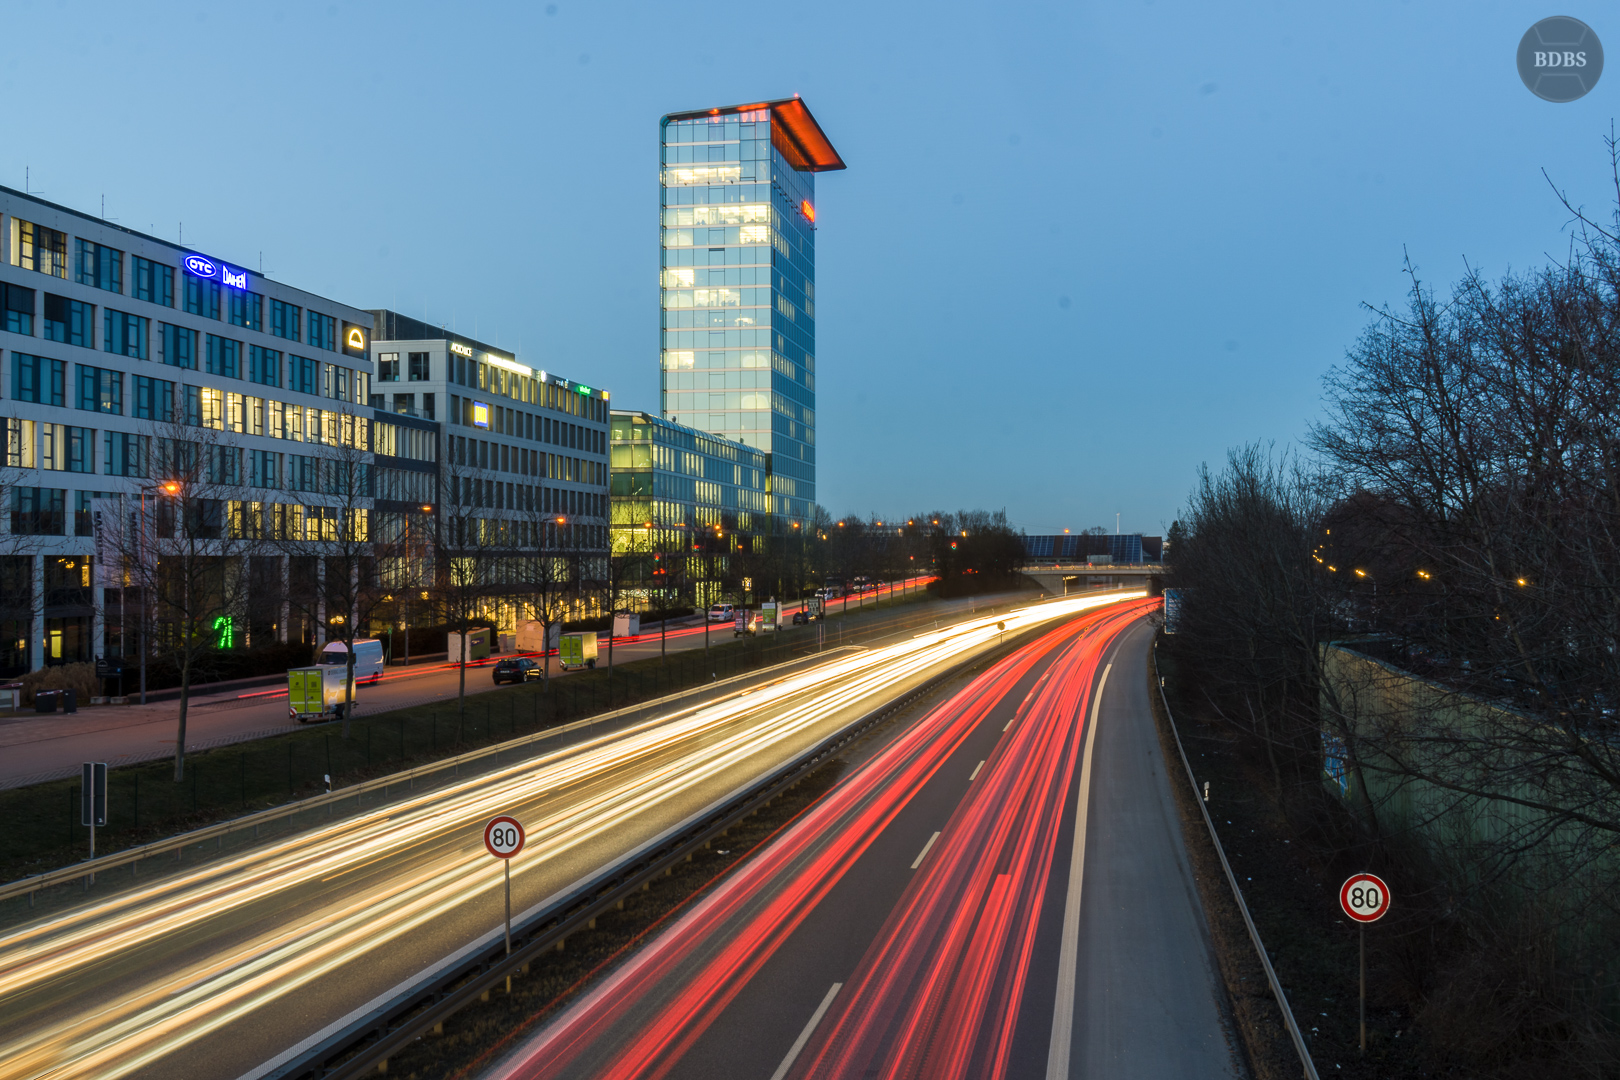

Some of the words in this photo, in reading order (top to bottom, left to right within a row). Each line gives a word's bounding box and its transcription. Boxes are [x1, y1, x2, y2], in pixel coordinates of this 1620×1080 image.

[189, 258, 213, 274] OTC
[492, 827, 516, 847] 80
[1351, 887, 1379, 909] 80
